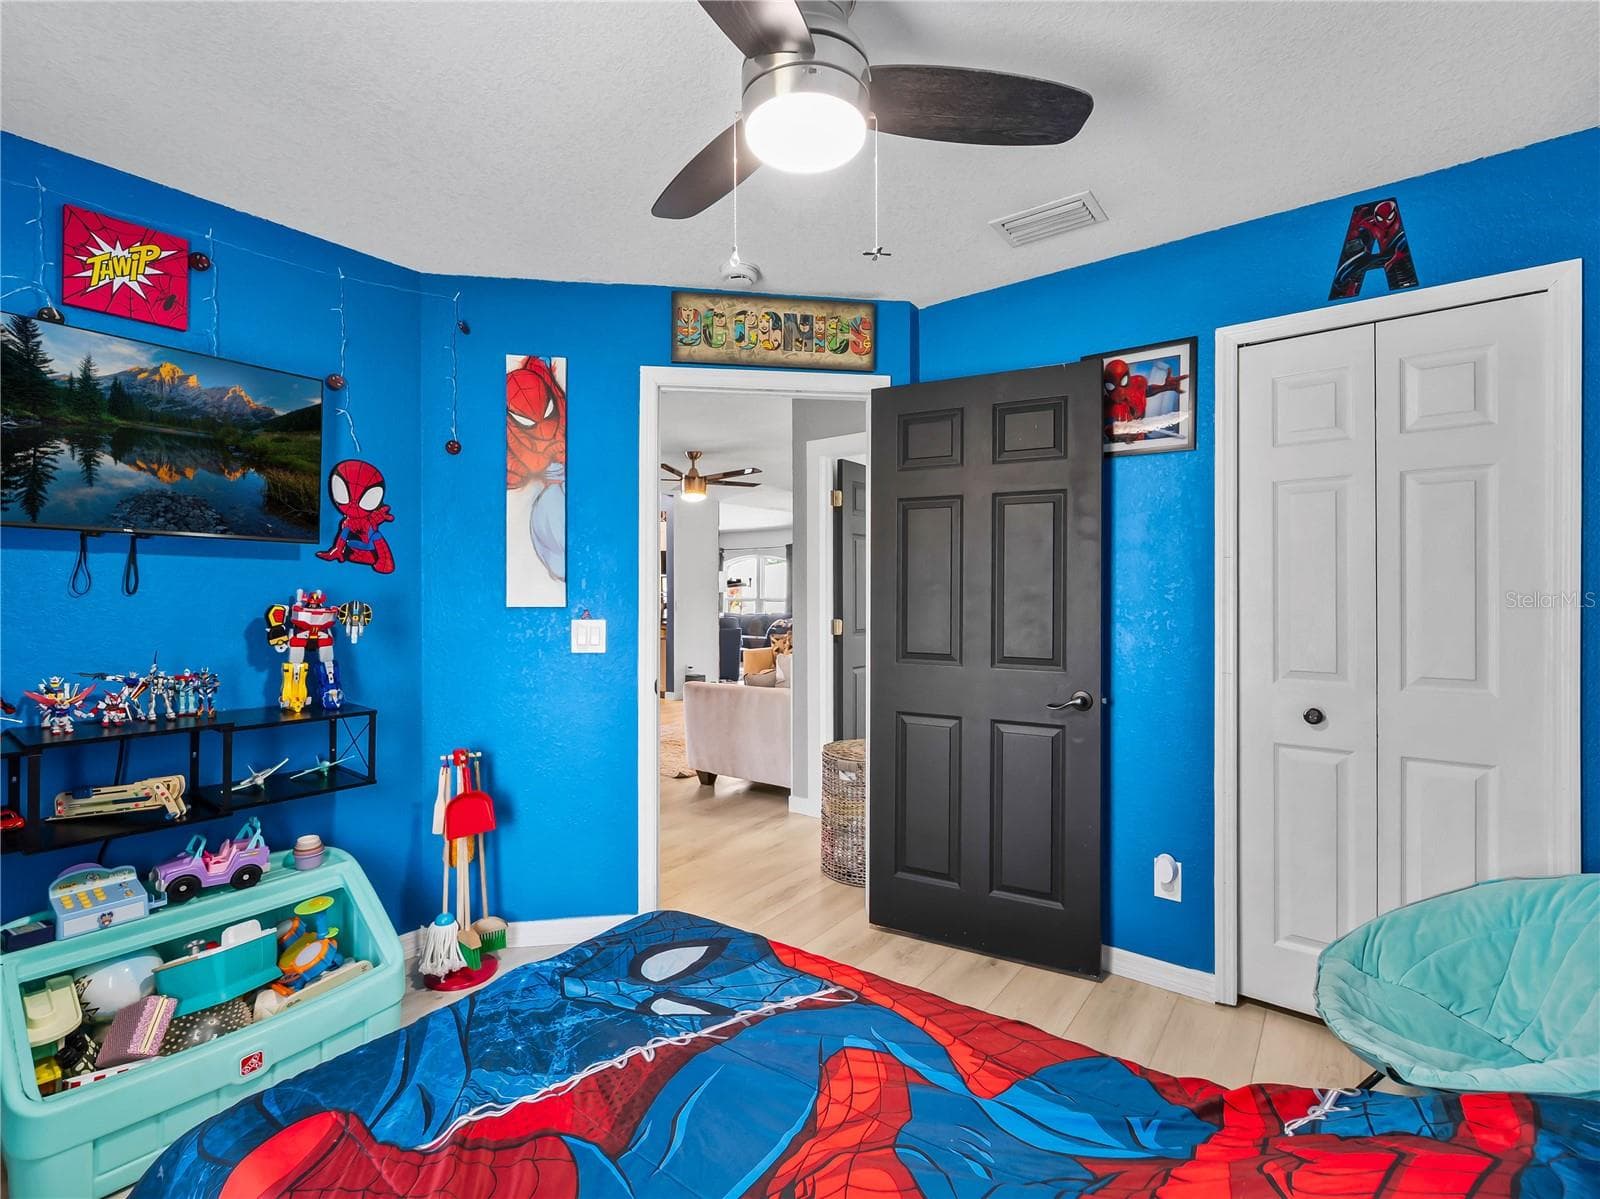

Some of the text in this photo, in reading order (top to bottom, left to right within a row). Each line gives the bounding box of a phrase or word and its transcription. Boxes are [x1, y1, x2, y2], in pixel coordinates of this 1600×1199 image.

[1328, 197, 1419, 300] A
[677, 305, 873, 356] DC COMICS
